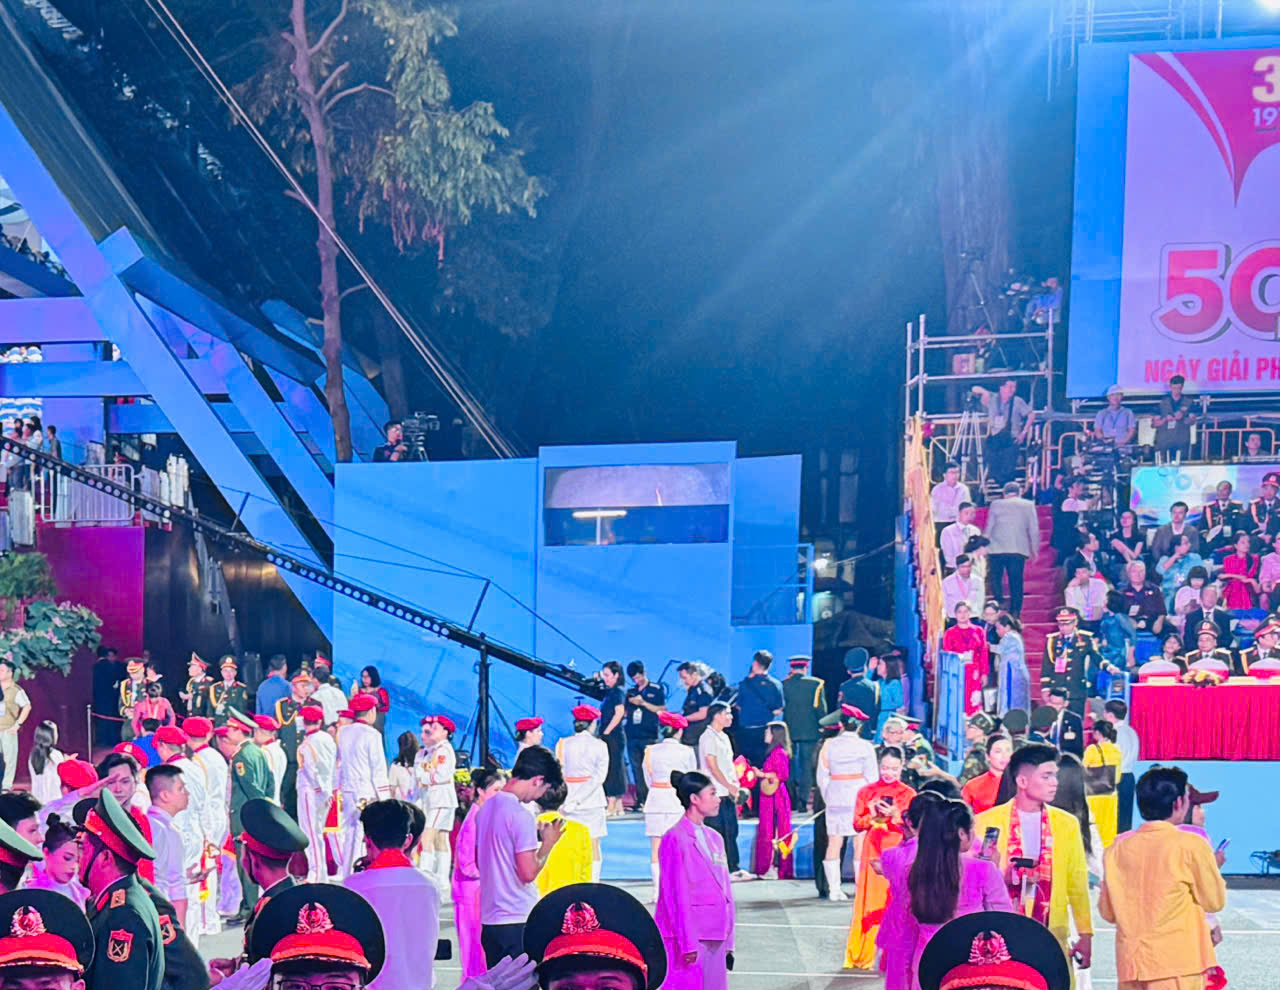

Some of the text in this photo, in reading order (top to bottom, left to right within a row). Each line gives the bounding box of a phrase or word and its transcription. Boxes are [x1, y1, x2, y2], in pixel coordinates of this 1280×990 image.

[1252, 107, 1280, 128] 19
[1145, 354, 1200, 383] NGÀY
[1207, 349, 1249, 381] GIẢI
